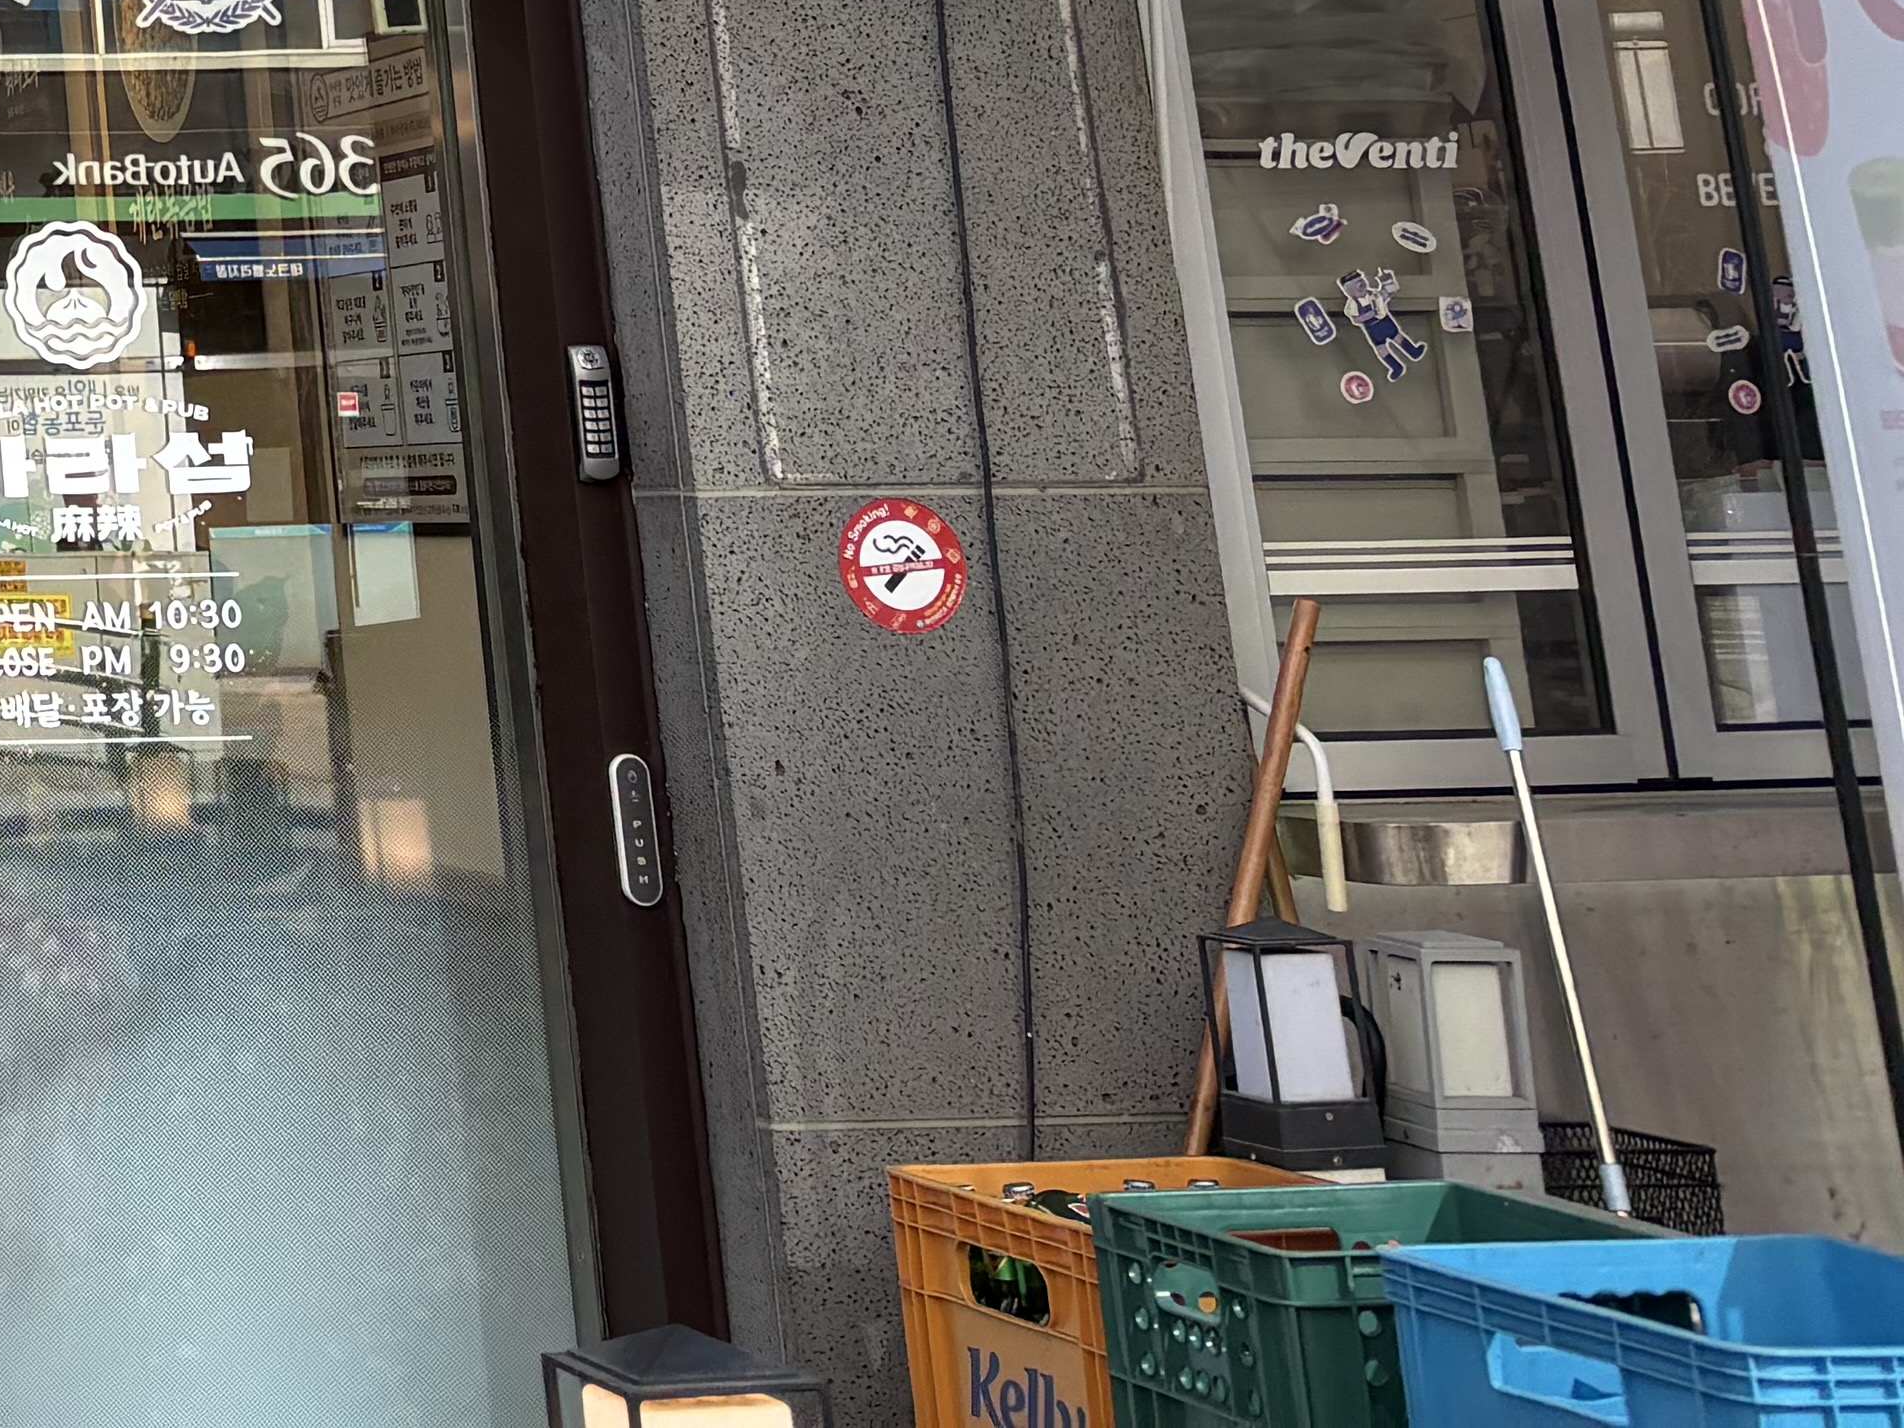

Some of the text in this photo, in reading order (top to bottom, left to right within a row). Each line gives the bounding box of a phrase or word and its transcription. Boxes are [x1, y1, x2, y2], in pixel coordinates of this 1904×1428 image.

[1696, 173, 1781, 207] BEE
[37, 394, 84, 413] HOT
[91, 394, 138, 413] POT
[161, 398, 210, 422] PUB
[82, 600, 132, 631] AM
[148, 599, 242, 630] 10:30
[81, 645, 132, 675] PM
[169, 643, 246, 674] 9:30
[154, 690, 215, 726] 가능
